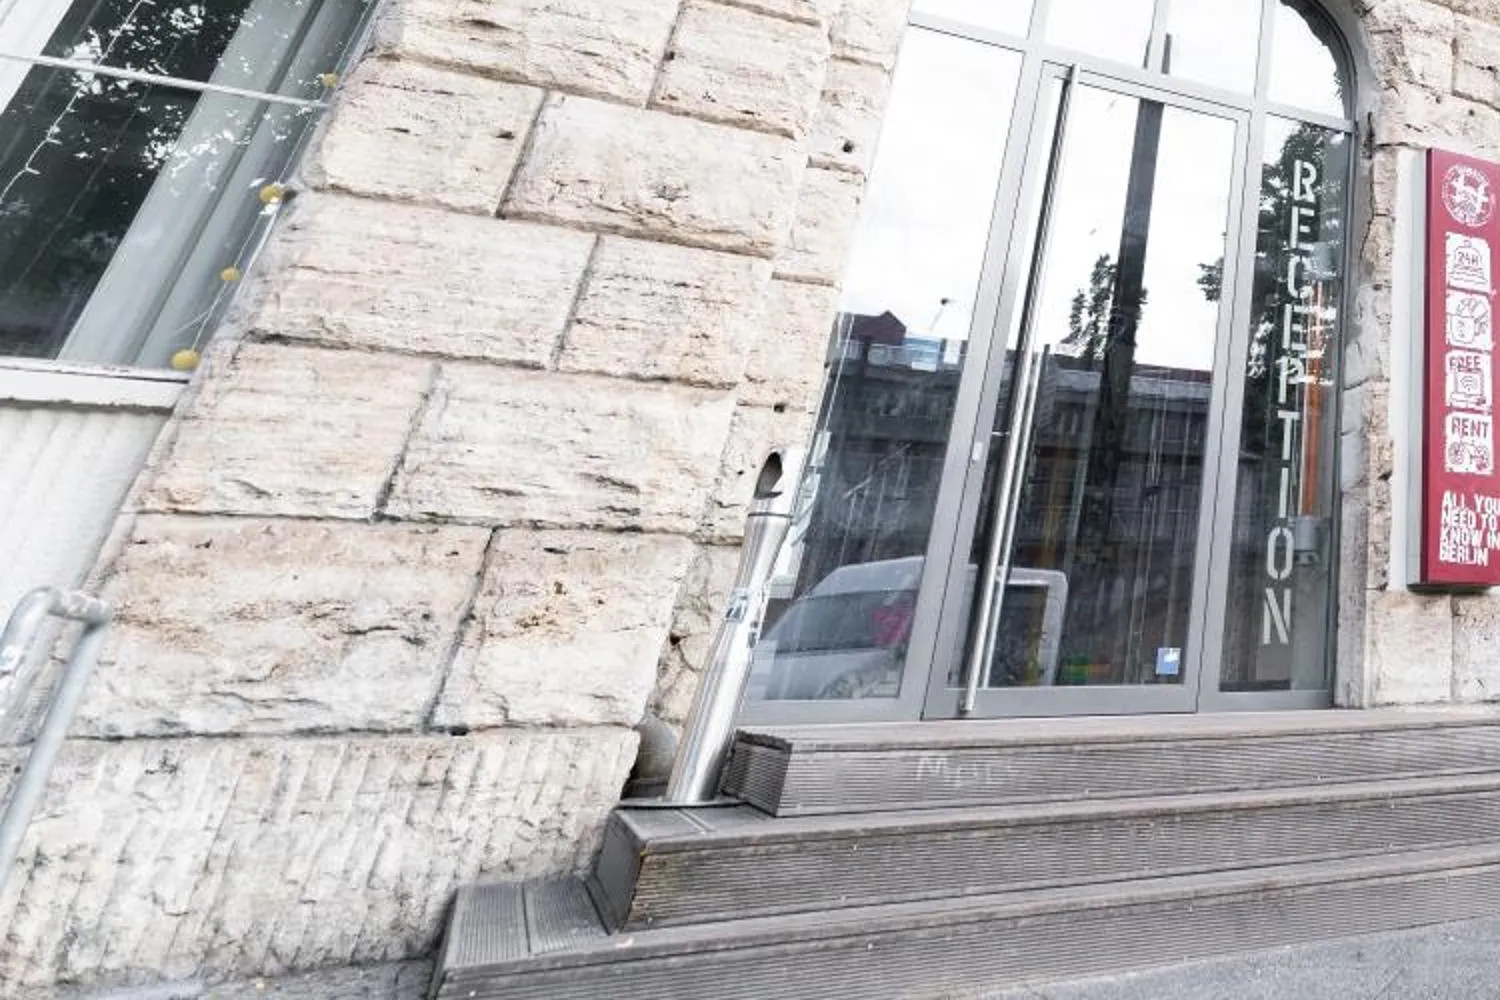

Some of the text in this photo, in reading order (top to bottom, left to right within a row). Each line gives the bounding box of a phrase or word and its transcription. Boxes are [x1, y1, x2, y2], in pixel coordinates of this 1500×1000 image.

[1449, 355, 1482, 371] FREE
[1262, 159, 1317, 645] RECEPTION
[1451, 415, 1489, 439] RENT
[1442, 491, 1465, 508] ALL
[1441, 508, 1499, 532] NEED TO
[1440, 526, 1483, 548] KNOW
[1440, 544, 1488, 566] BERLIN
